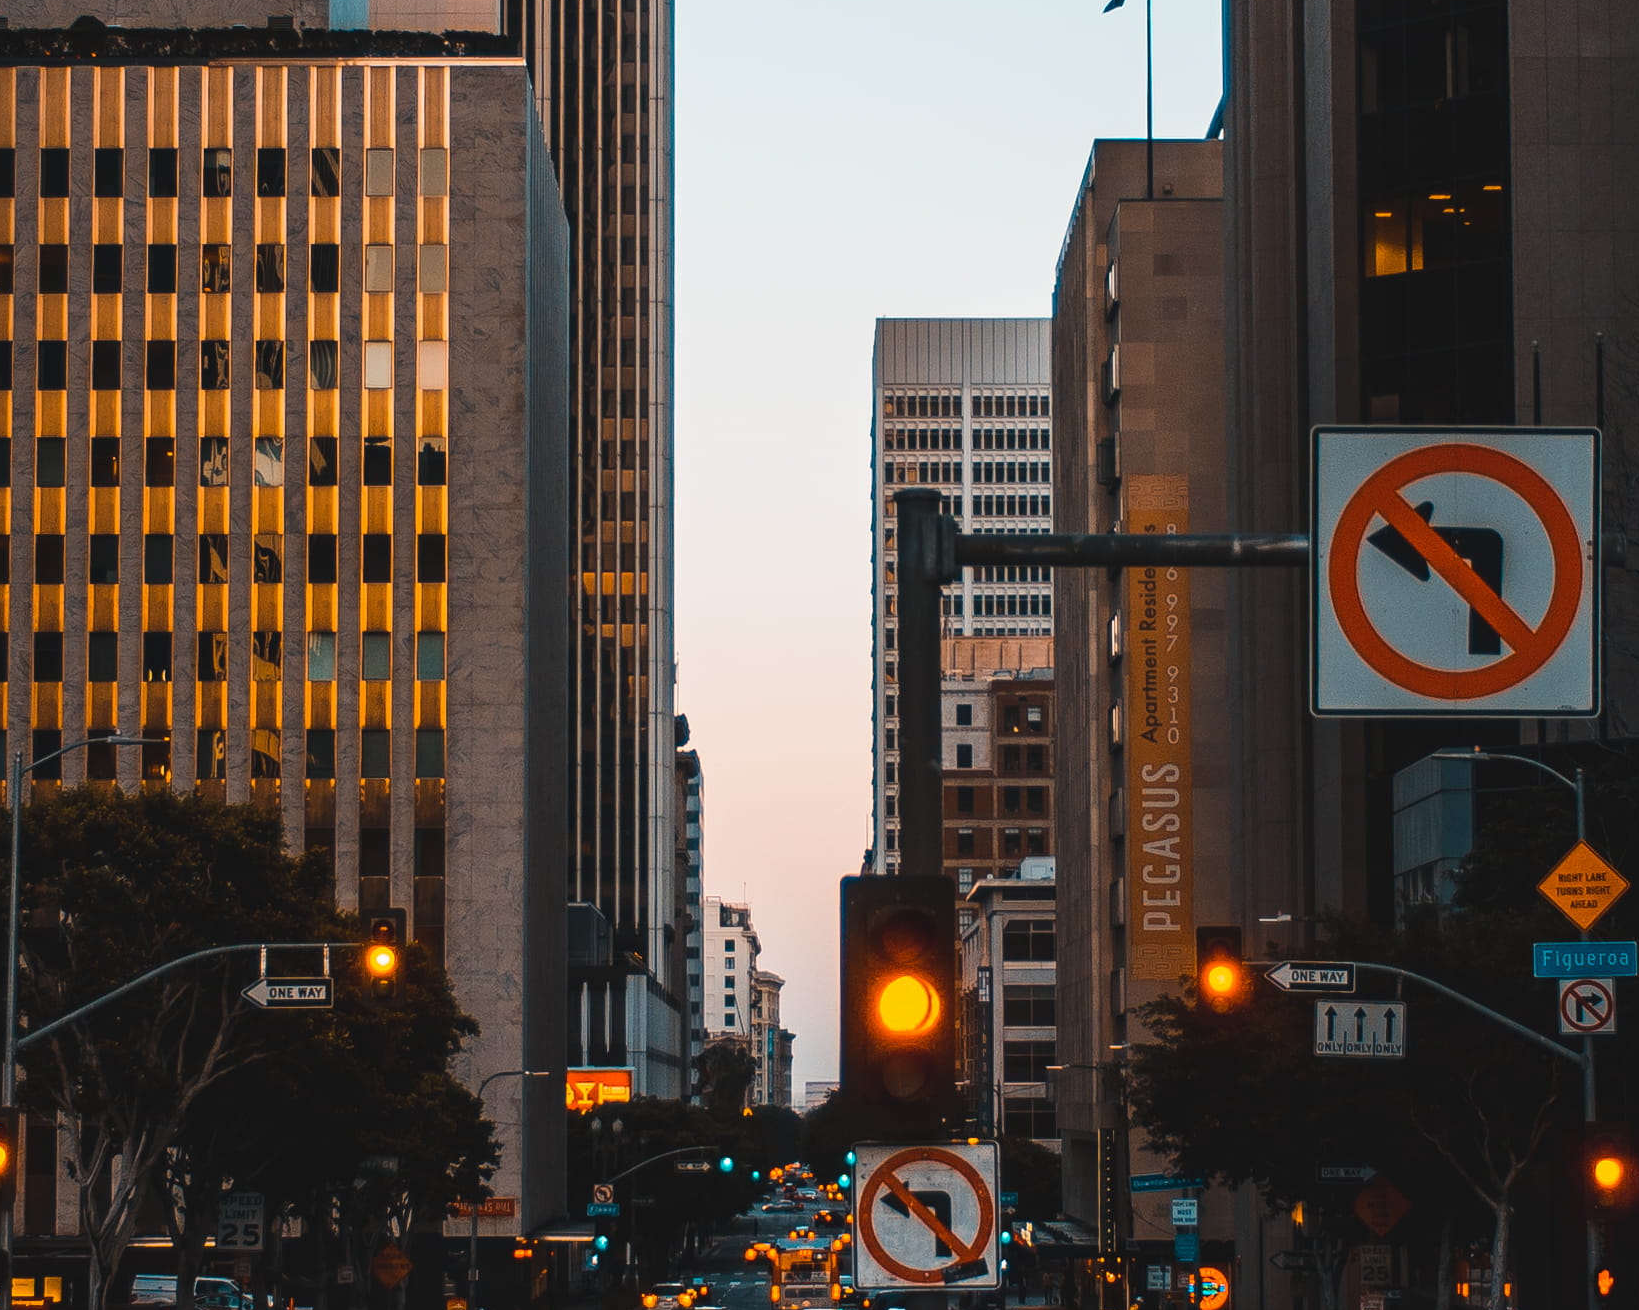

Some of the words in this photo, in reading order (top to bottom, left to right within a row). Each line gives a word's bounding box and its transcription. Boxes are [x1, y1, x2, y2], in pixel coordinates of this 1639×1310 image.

[1140, 639, 1163, 744] Apartment
[1142, 763, 1180, 930] PEGASUS
[1558, 872, 1583, 882] RIGHT
[1585, 872, 1607, 882] LANE
[1555, 886, 1583, 896] TURNS
[1586, 885, 1611, 895] RIGHT
[1570, 899, 1598, 908] AHEAD
[1542, 950, 1629, 971] Figueroa
[1291, 970, 1316, 982] ONE
[1319, 971, 1345, 982] WAY
[269, 988, 294, 998] ONE
[298, 988, 323, 998] WAY
[1317, 1042, 1343, 1052] ONLY
[1346, 1043, 1372, 1053] ONLY
[1375, 1043, 1402, 1054] ONLY
[221, 1224, 260, 1246] 25
[1363, 1266, 1389, 1282] 25
